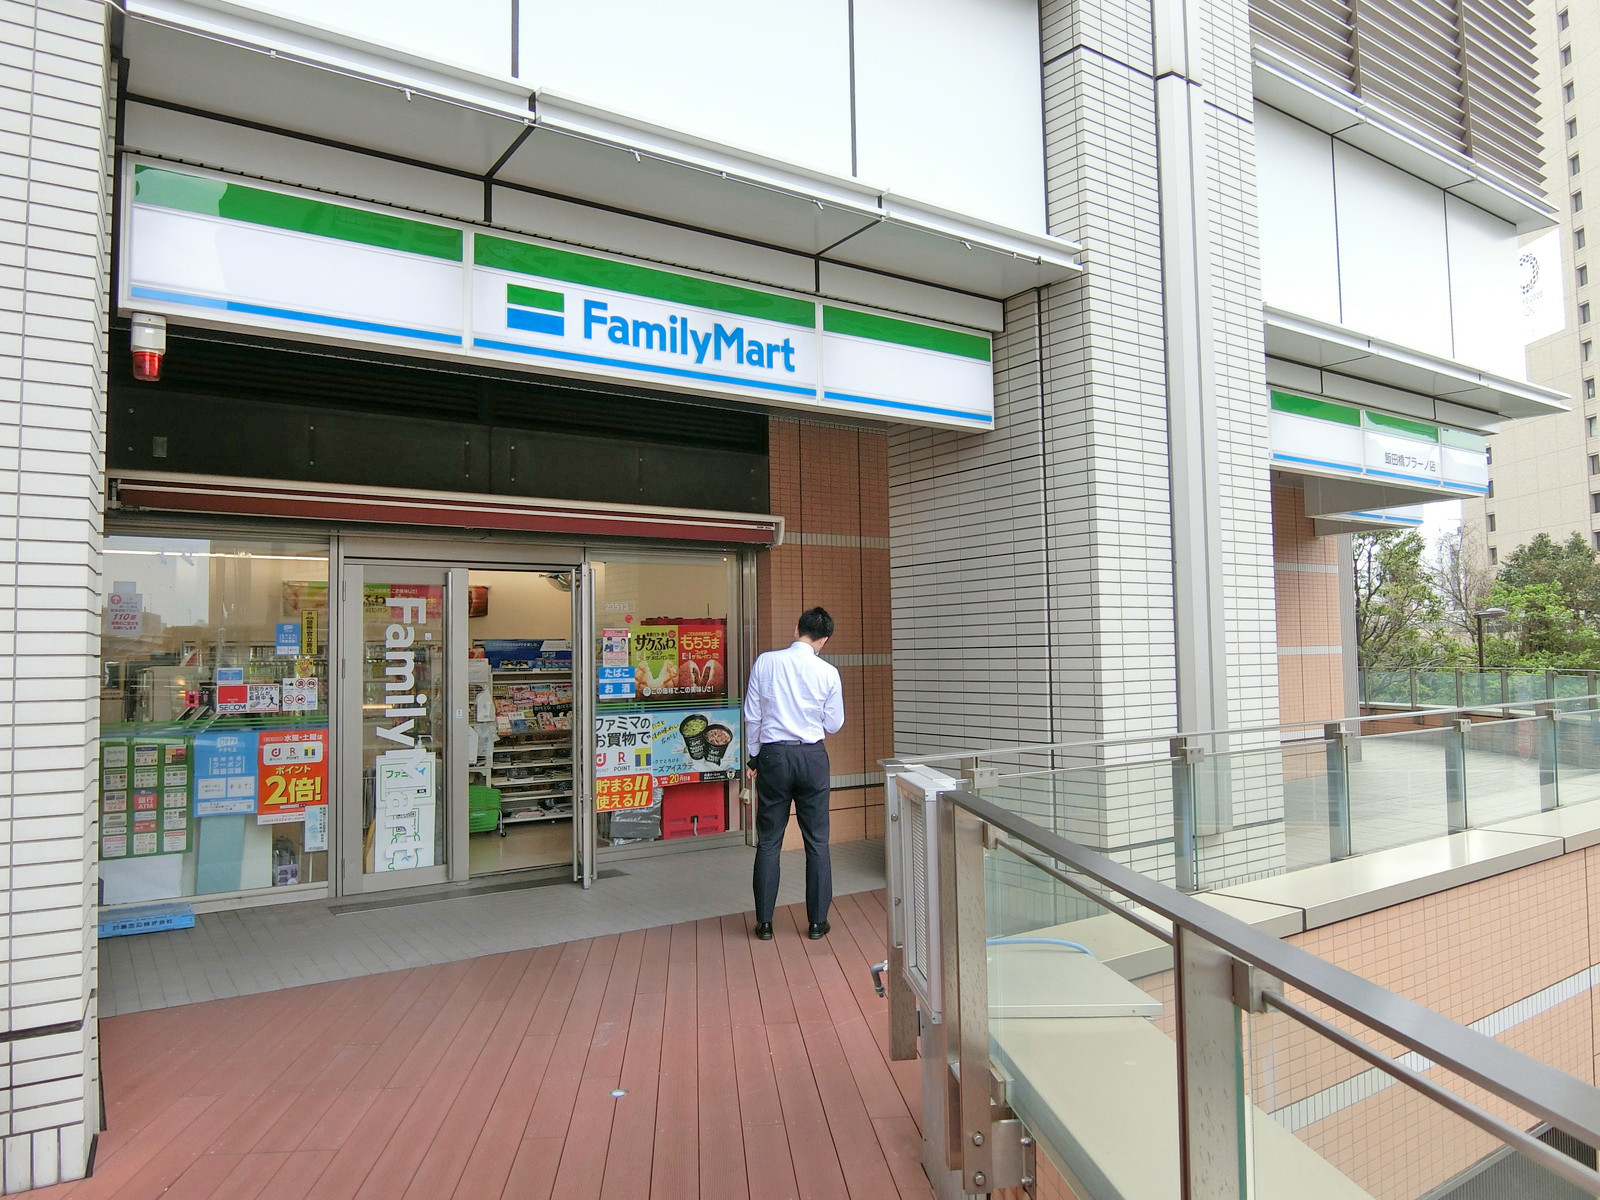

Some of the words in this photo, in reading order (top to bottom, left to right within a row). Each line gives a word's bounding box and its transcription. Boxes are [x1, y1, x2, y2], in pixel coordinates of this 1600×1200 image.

[583, 298, 796, 373] FamilyMart
[1384, 451, 1436, 472] 飯田橋プラーノ店
[680, 634, 720, 651] もちうま
[604, 668, 630, 678] たばこ
[218, 703, 247, 711] SECOM
[595, 716, 651, 732] ファミマの
[595, 731, 652, 748] お買物で
[275, 765, 312, 775] ポイント
[263, 775, 322, 805] 2倍!
